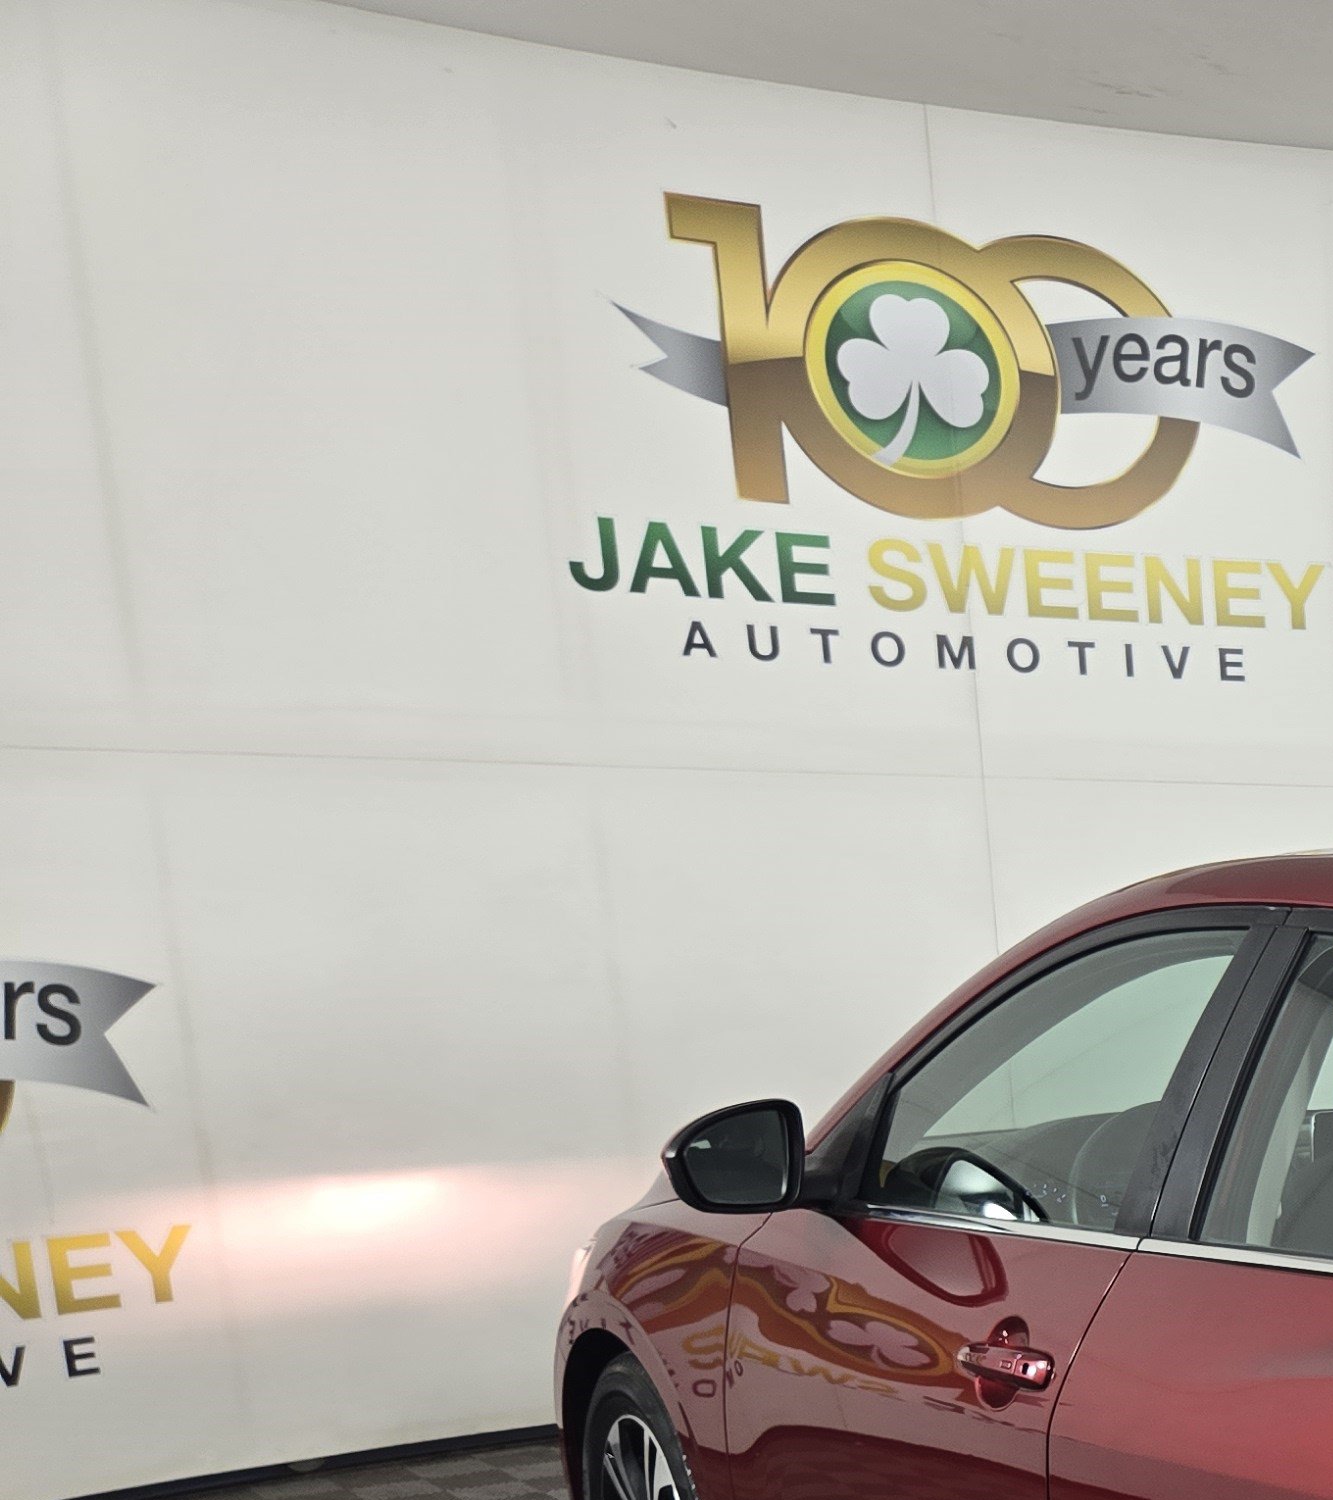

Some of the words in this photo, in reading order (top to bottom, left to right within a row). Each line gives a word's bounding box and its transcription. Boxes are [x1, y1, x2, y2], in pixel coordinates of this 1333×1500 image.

[1070, 332, 1257, 401] years
[568, 515, 837, 607] JAKE
[867, 537, 1324, 631] SWEENEY
[682, 620, 1246, 682] AUTOMOTIVE
